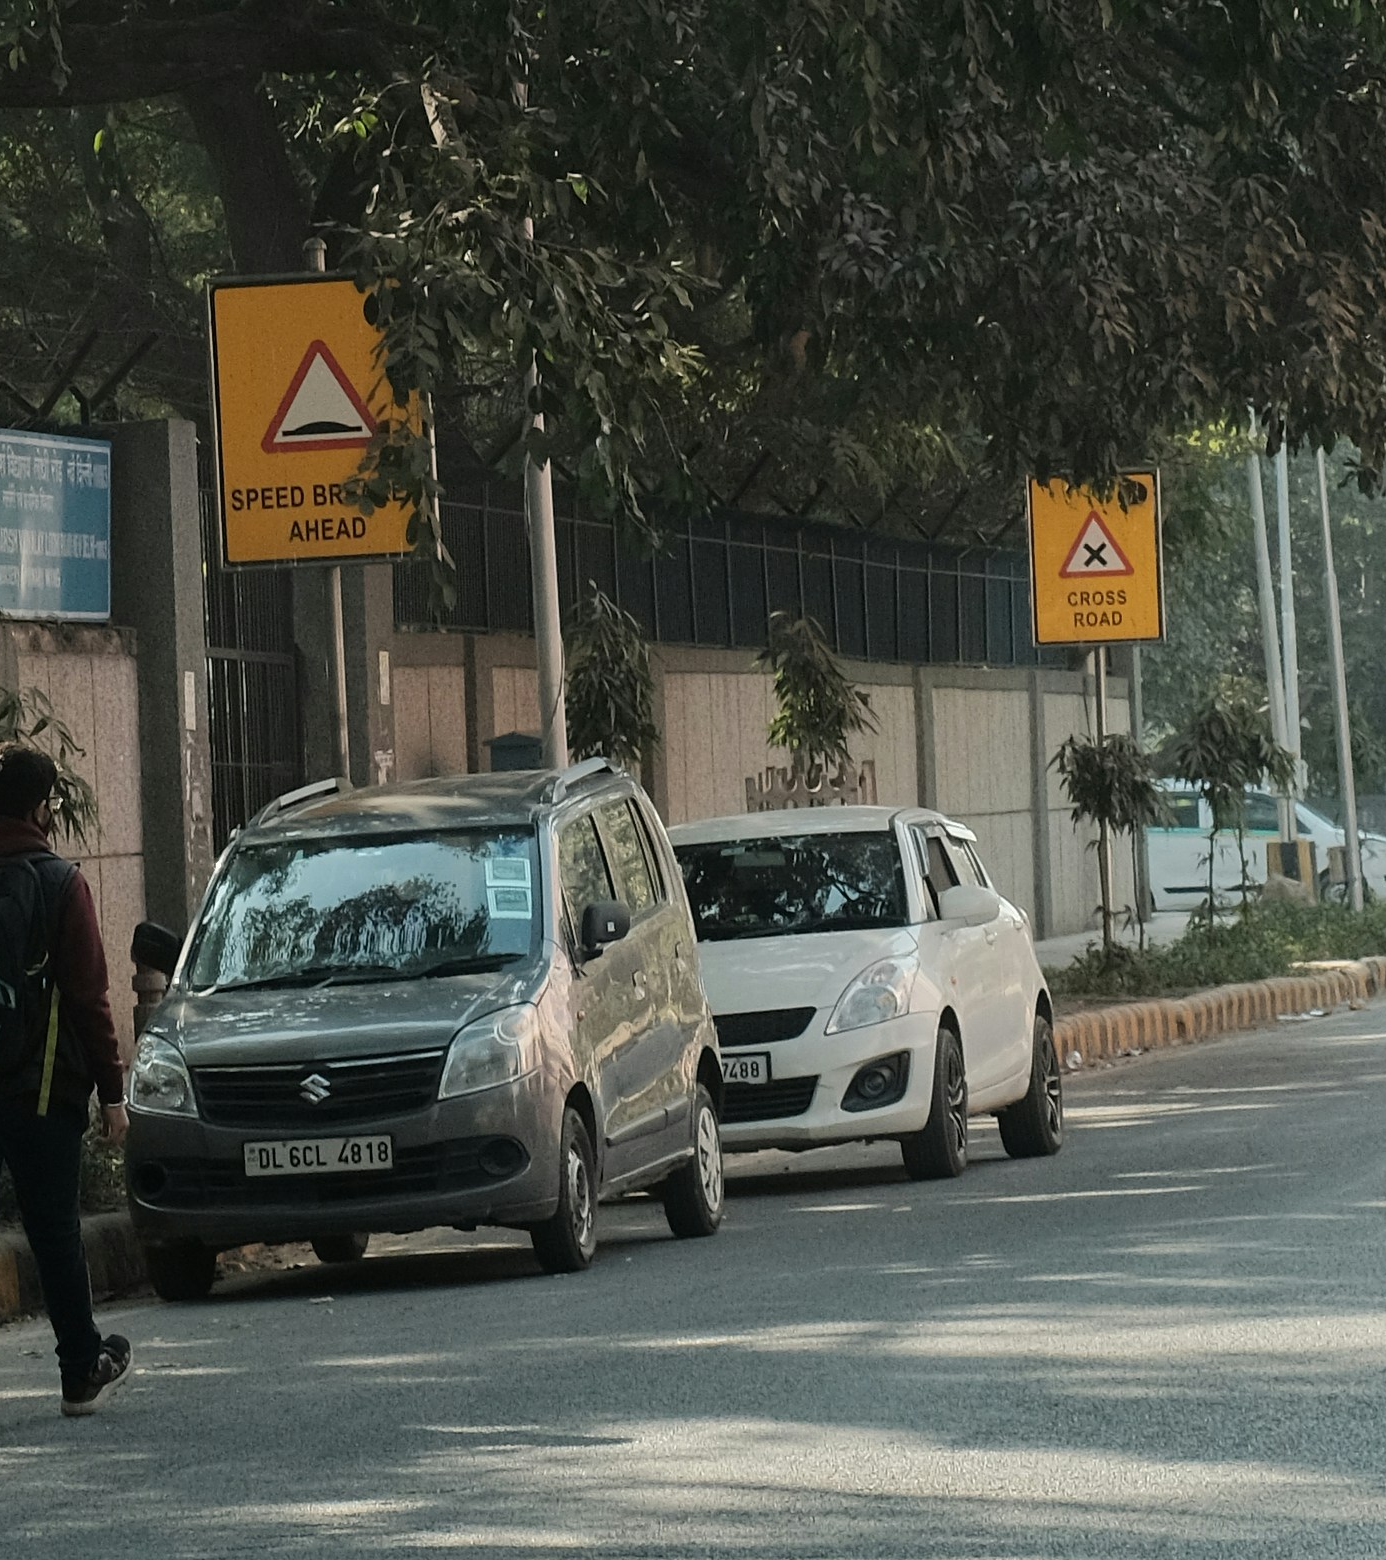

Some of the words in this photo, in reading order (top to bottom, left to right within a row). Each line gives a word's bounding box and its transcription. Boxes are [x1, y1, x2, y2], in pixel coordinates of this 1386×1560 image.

[231, 485, 305, 511] SPEED
[289, 516, 367, 543] AHEAD
[1067, 589, 1128, 607] CROSS
[1073, 611, 1123, 628] ROAD
[722, 1061, 760, 1079] 7488
[258, 1146, 284, 1170] DL
[289, 1145, 327, 1168] 6CL
[338, 1141, 389, 1165] 4818
